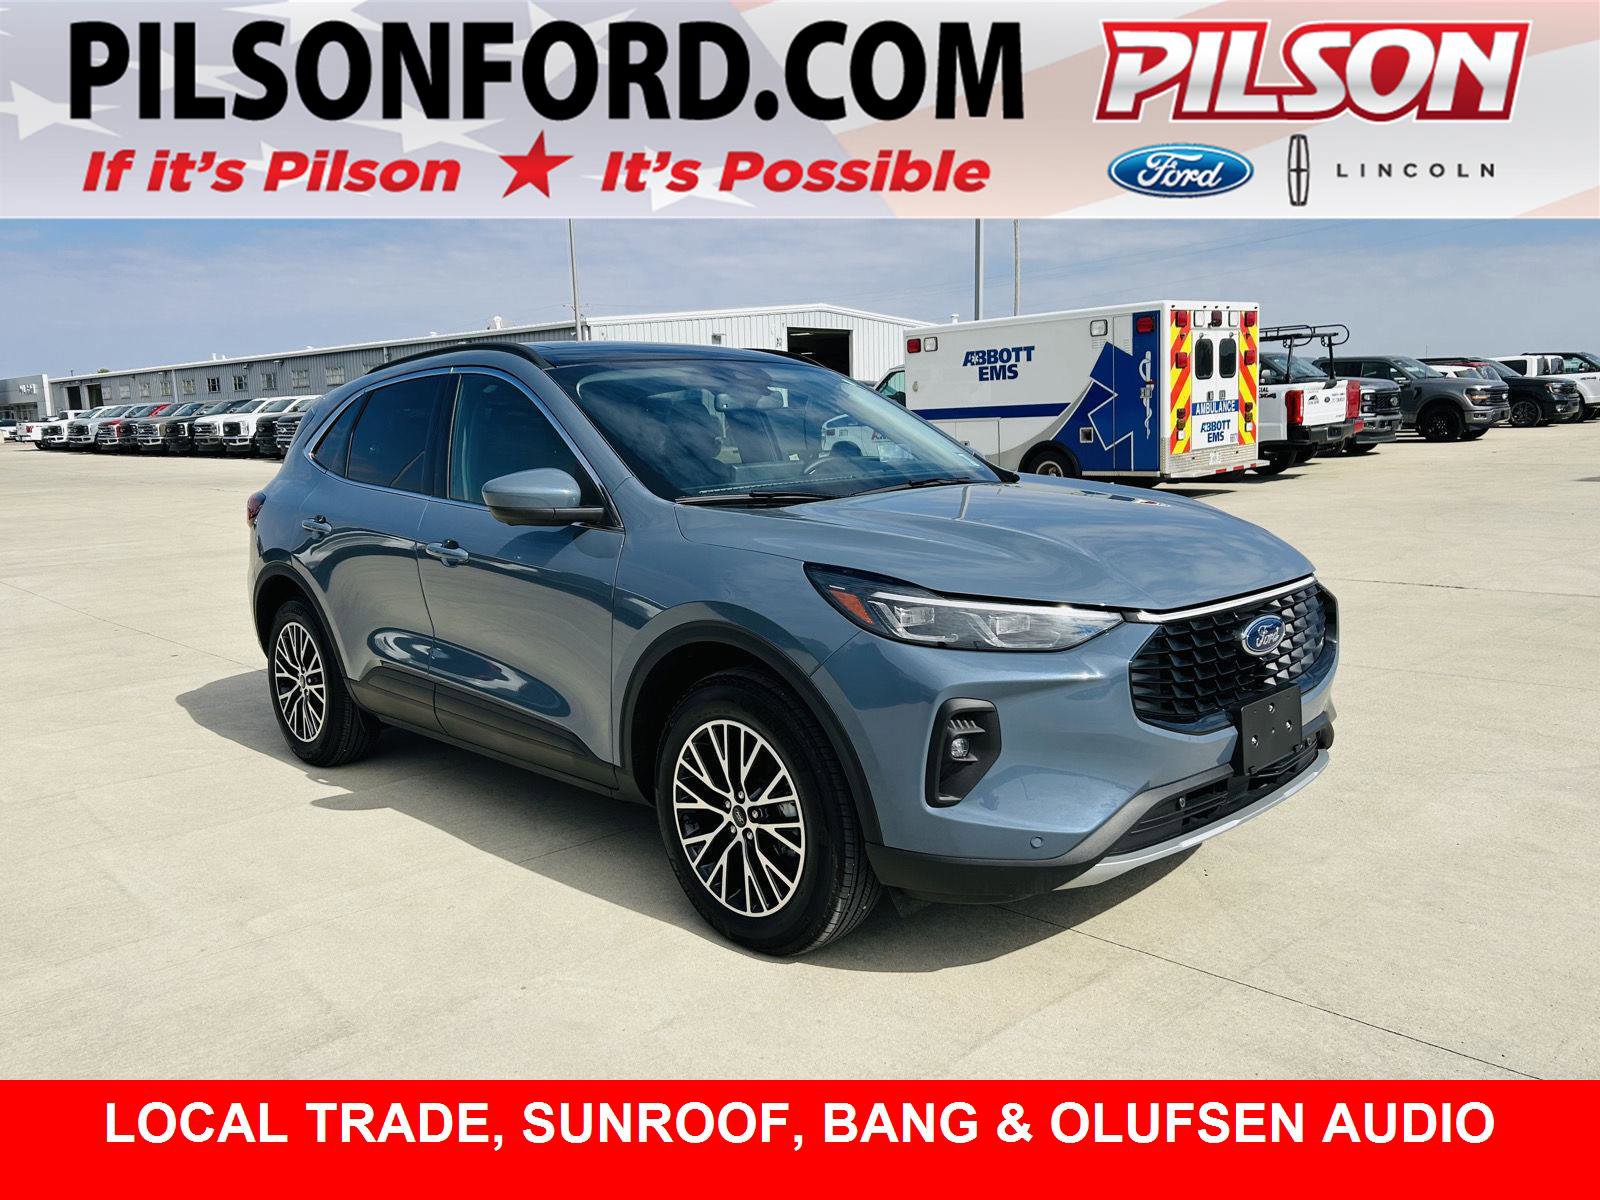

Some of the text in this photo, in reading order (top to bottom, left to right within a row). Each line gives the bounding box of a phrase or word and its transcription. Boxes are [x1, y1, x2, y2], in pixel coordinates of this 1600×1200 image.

[962, 345, 1035, 367] ABBOTT
[978, 365, 1019, 382] EMS
[1195, 400, 1236, 416] AMBULANCE
[1200, 419, 1231, 433] ABBOTT
[1207, 431, 1225, 443] EMS
